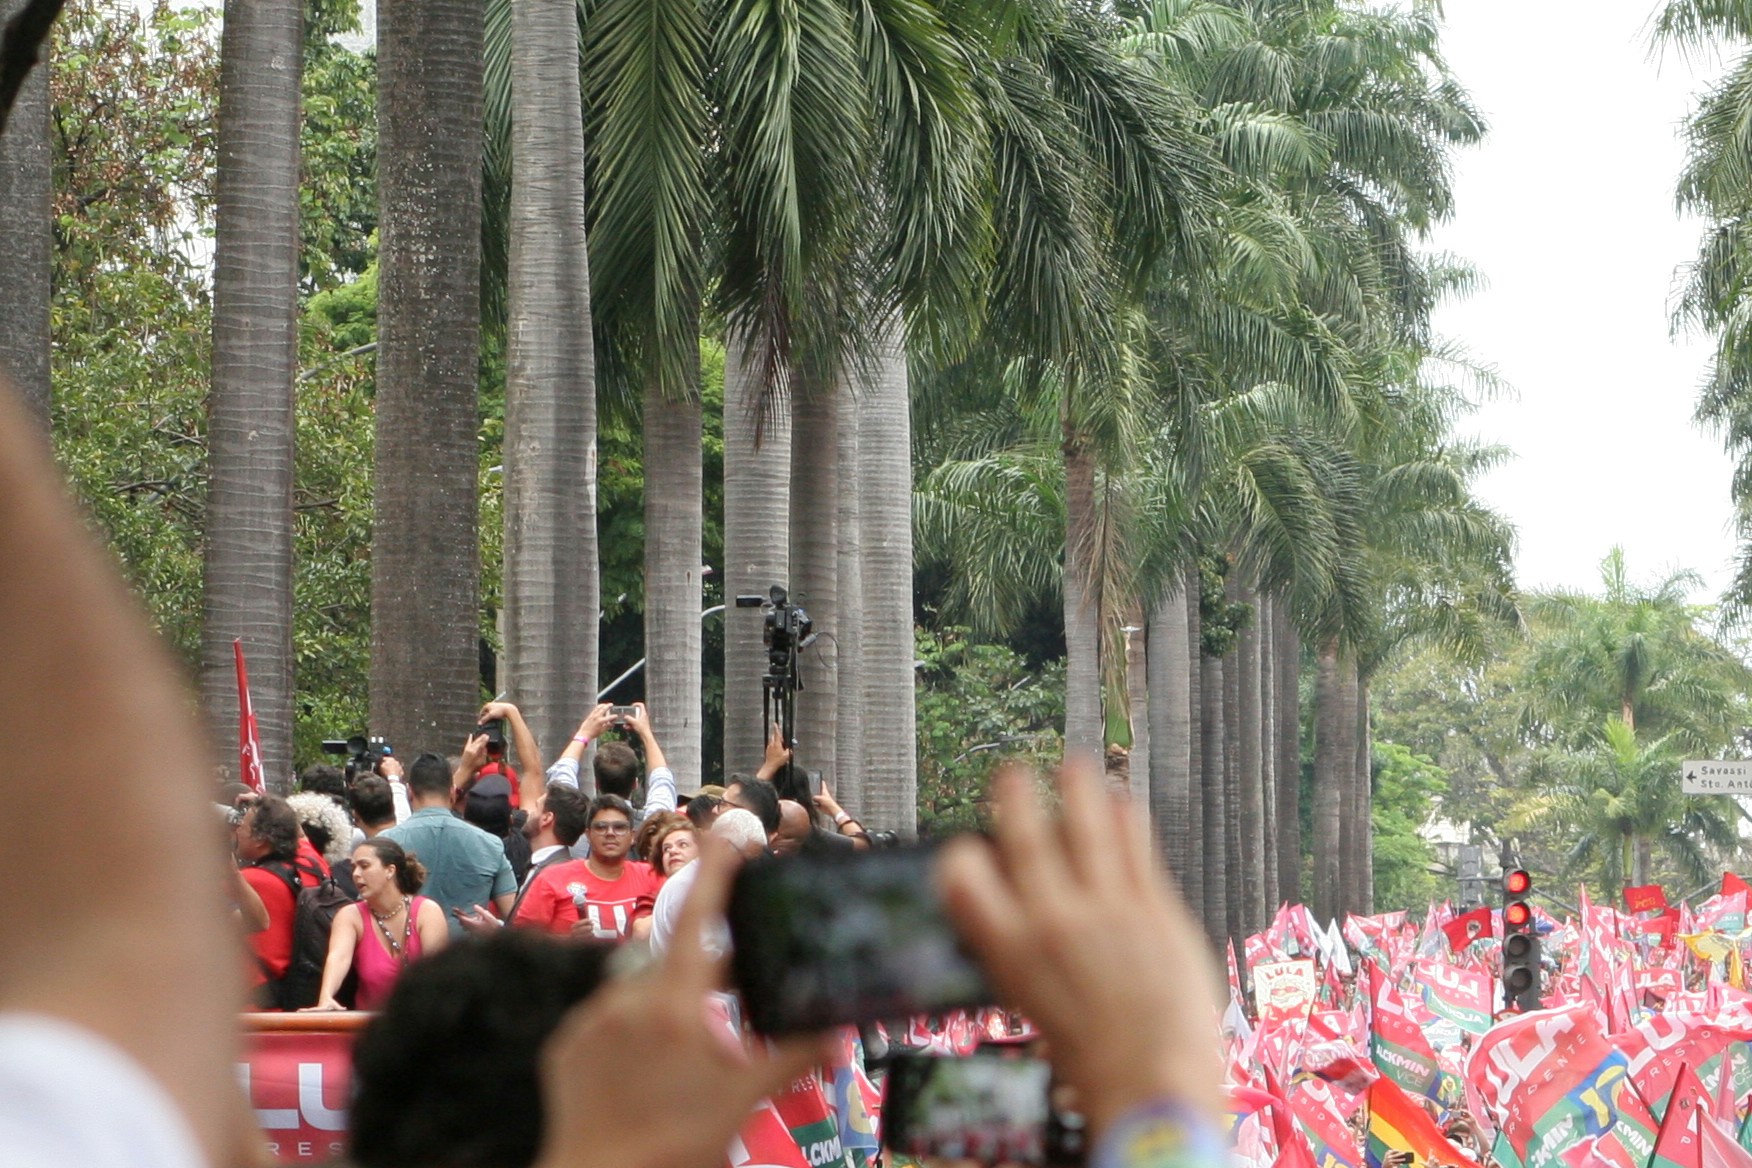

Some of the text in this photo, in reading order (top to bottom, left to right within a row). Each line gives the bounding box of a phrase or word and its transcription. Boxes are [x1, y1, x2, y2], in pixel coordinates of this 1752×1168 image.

[1701, 766, 1747, 776] Savassi
[1265, 966, 1304, 980] LULA
[1395, 1068, 1424, 1088] VICE
[235, 1062, 350, 1131] LU
[801, 1134, 844, 1168] LCKM
